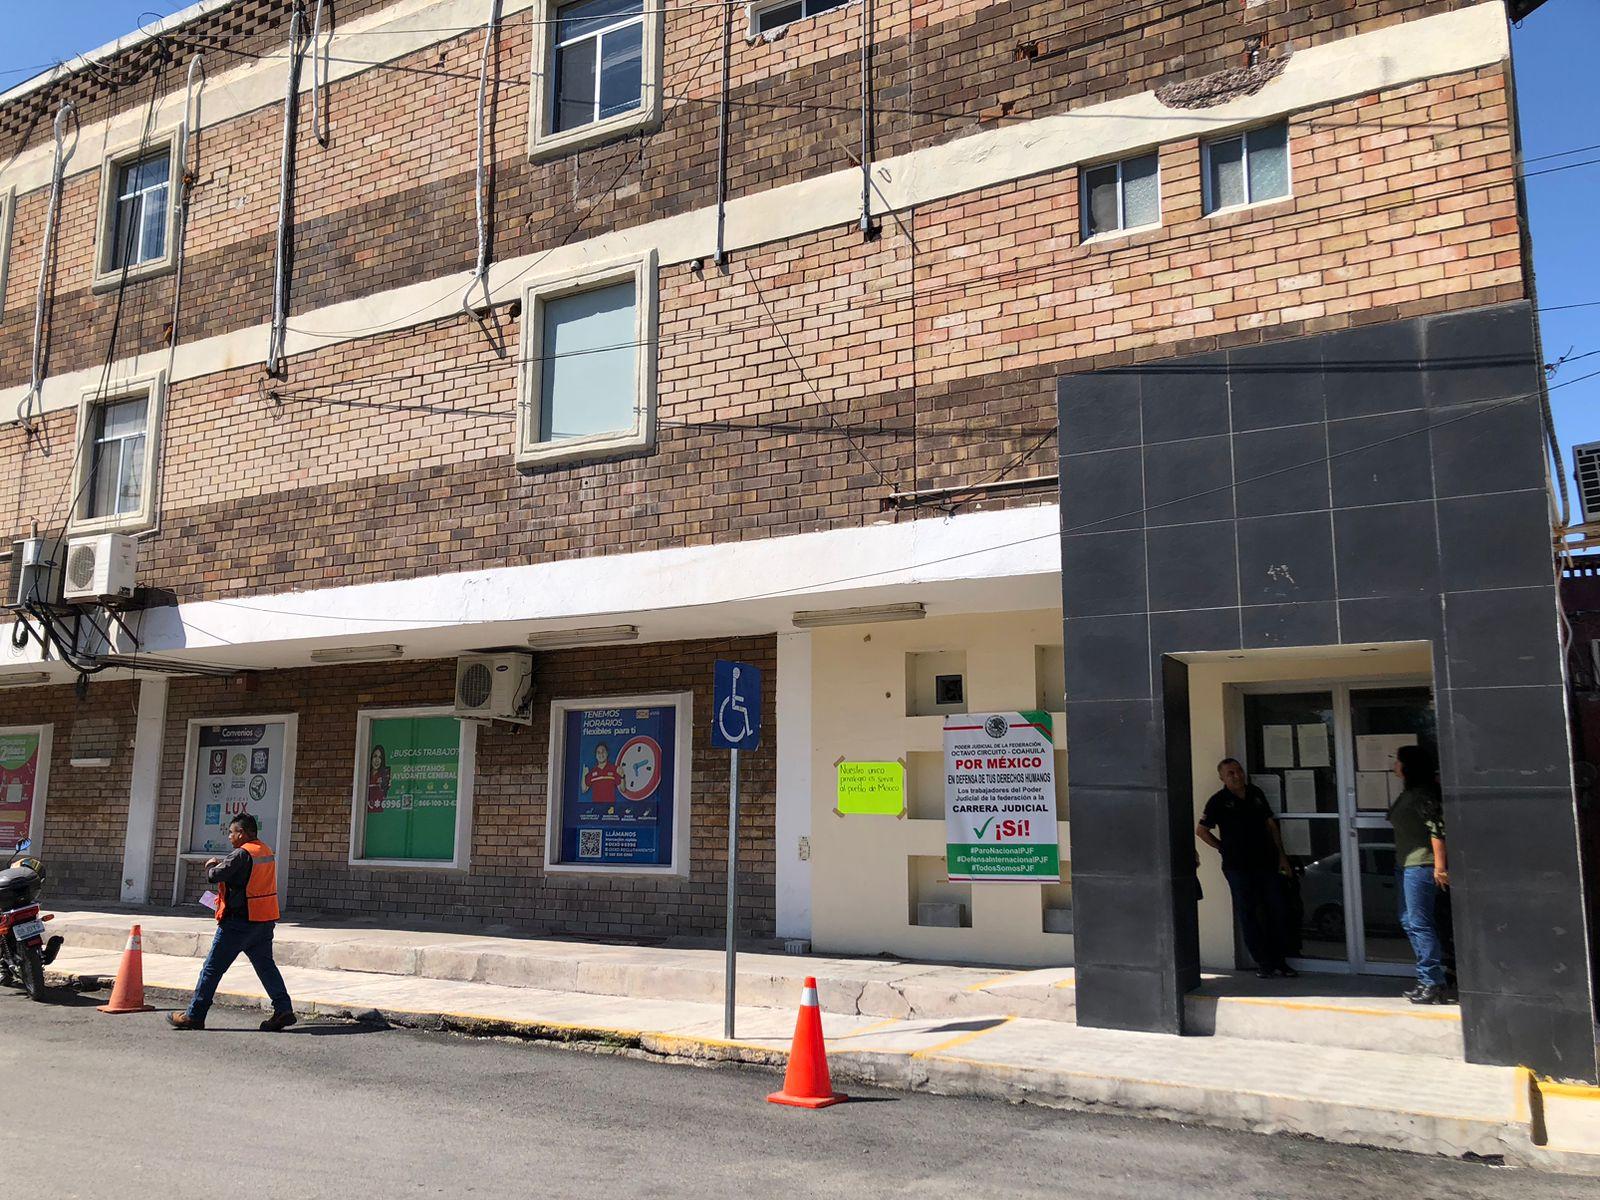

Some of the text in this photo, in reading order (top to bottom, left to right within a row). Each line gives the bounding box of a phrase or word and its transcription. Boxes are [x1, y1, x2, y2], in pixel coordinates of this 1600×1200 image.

[584, 710, 620, 718] TENEMOS
[583, 719, 622, 727] HORARIOS
[222, 728, 253, 737] Convenios
[614, 728, 629, 736] para
[956, 756, 1042, 770] POR MÉXICO
[428, 771, 457, 779] GENERAL
[948, 773, 1051, 784] EN DEFENSA DE TUS DERECHOS HUMANOS
[970, 787, 1009, 795] trabajadores
[225, 802, 248, 815] LUX
[953, 804, 1048, 813] CARRERA JUDICIAL
